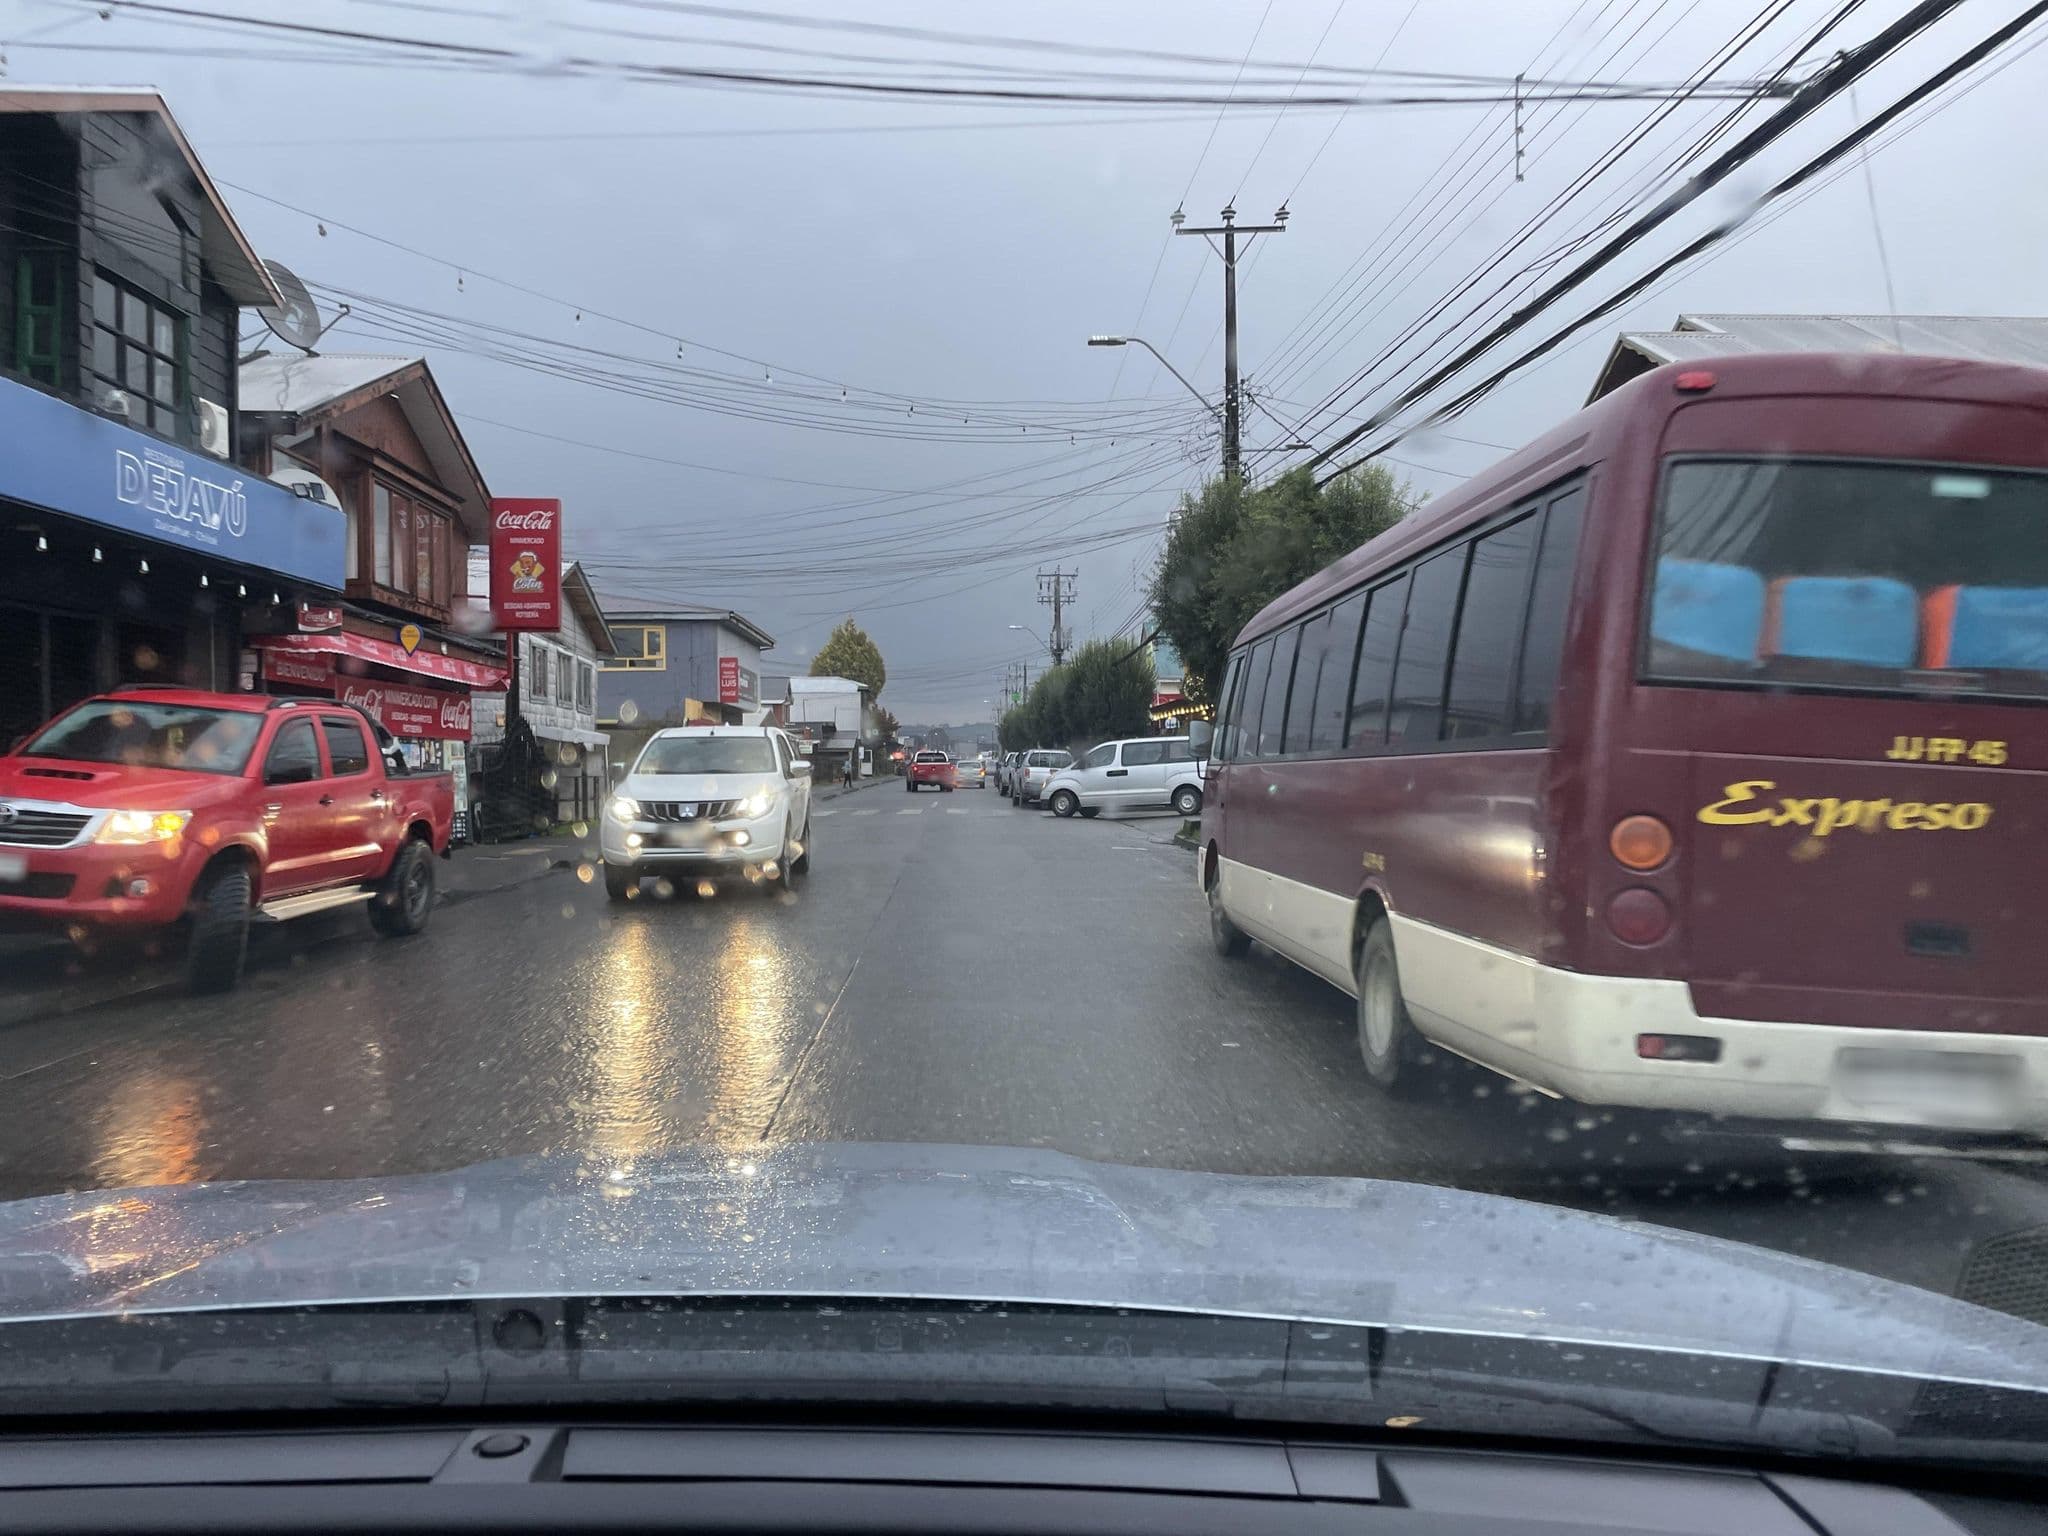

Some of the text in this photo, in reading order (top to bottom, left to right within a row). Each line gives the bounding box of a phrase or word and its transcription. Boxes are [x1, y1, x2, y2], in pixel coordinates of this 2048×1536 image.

[116, 449, 247, 538] DEJAVÚ
[496, 510, 555, 530] Coca-Cola
[509, 537, 545, 545] MINIMERCADO
[721, 679, 737, 688] LUIS
[384, 690, 423, 708] MINIMERCADO
[441, 698, 471, 730] Coca-Cola
[1696, 780, 1993, 837] Expreso
